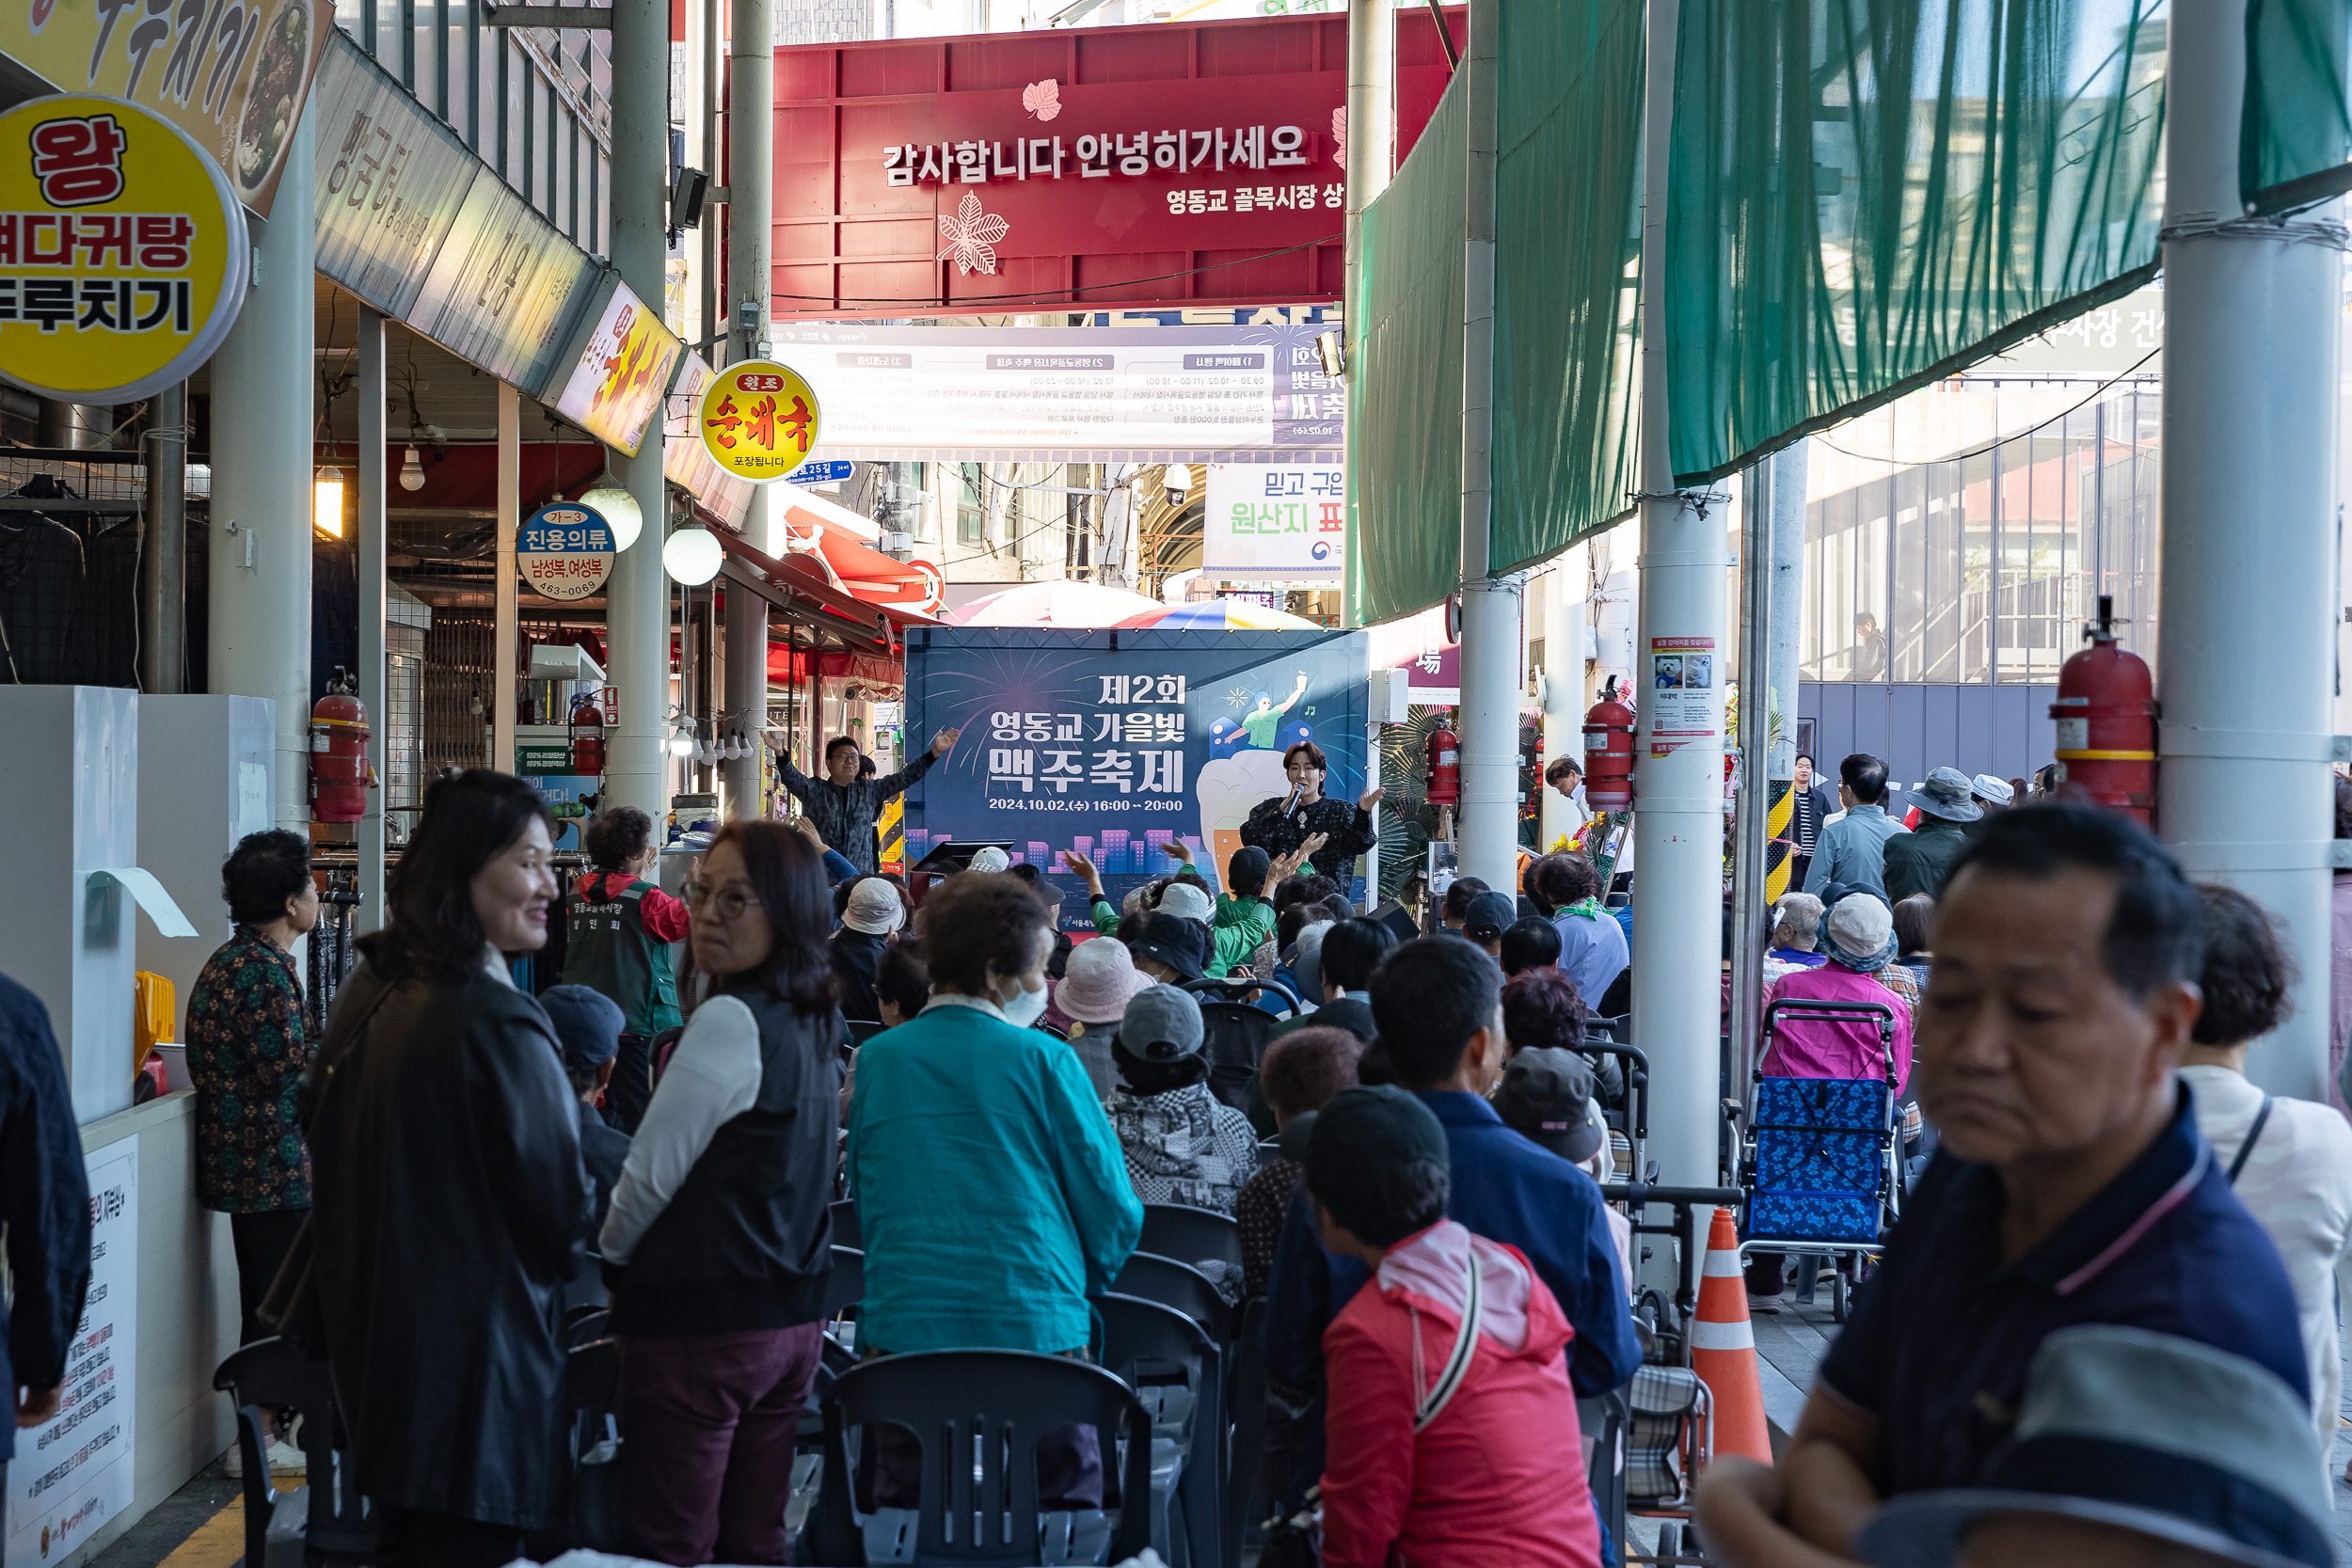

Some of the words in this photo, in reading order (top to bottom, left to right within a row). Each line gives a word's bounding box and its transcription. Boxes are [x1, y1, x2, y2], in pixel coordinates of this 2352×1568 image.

[30, 114, 127, 207] 왕
[328, 110, 412, 224] 빵굼터
[883, 135, 1064, 187] 감사합니다
[1075, 125, 1307, 179] 안녕히가세요
[1167, 188, 1229, 214] 영동교
[1233, 184, 1317, 213] 골목시장
[742, 375, 779, 391] 원조
[707, 395, 813, 451] 순대국
[734, 456, 785, 467] 포장됩니다
[1264, 472, 1304, 497] 믿고
[550, 512, 581, 523] 가-3
[1231, 503, 1309, 534] 원산지
[526, 530, 608, 551] 진용의류
[539, 580, 596, 595] 463-0069
[1098, 674, 1185, 705] 제2회
[991, 711, 1084, 742] 영동교
[1093, 712, 1185, 743] 가을빛
[989, 749, 1184, 794] 맥주축제
[989, 799, 1089, 813] 2024.10.02.(수)
[1093, 800, 1130, 812] 16:00
[1144, 800, 1184, 812] 20:00
